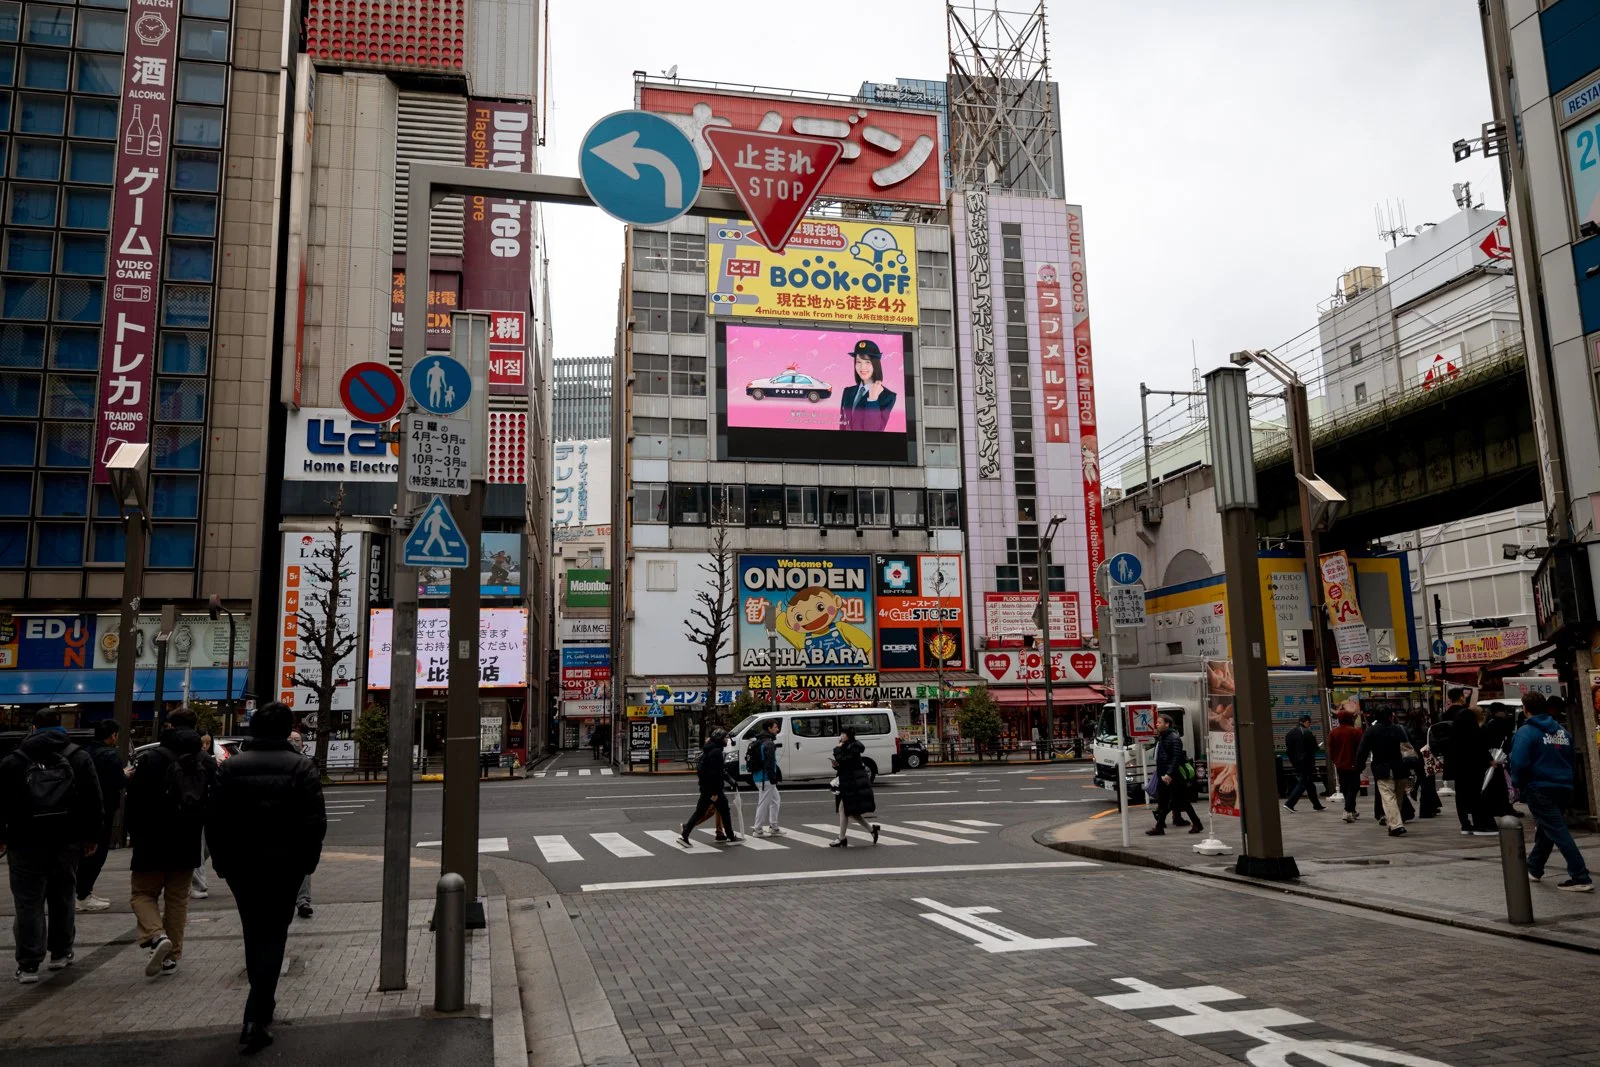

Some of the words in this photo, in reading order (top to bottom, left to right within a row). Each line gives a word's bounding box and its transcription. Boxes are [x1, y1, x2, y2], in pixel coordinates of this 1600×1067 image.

[132, 55, 167, 87] 酒
[129, 90, 166, 100] ALCOHOL
[734, 143, 815, 175] 止まれ
[749, 176, 804, 201] STOP
[119, 167, 159, 256] ゲーム
[490, 198, 525, 258] ree
[1067, 212, 1082, 258] ADULT
[820, 238, 842, 246] here
[116, 260, 153, 270] VIDEO
[116, 270, 152, 279] GAME
[1070, 261, 1086, 313] GOODS
[777, 292, 906, 313] 現在地から徒歩4分
[792, 309, 812, 317] walk
[813, 310, 833, 318] from
[834, 311, 853, 320] here
[489, 317, 520, 339] 税
[108, 312, 146, 405] トレカ
[1040, 292, 1066, 438] ラブメルシー
[1075, 337, 1089, 375] LOVE
[489, 359, 520, 376] 세점
[1077, 378, 1093, 426] MERCI
[104, 411, 143, 421] TRADING
[110, 421, 136, 431] CARD
[303, 460, 345, 472] Home
[350, 461, 399, 473] Electro
[408, 475, 469, 489] (特定禁止区間)
[777, 559, 822, 568] Welcome
[823, 560, 834, 568] to
[744, 567, 865, 589] ONODEN
[1270, 593, 1299, 601] Kanebo
[26, 618, 89, 668] EDION
[799, 676, 823, 688] TAX
[824, 675, 852, 687] FREE
[853, 673, 878, 687] 免税
[808, 688, 861, 701] ONODEN
[864, 687, 912, 699] CAMERA
